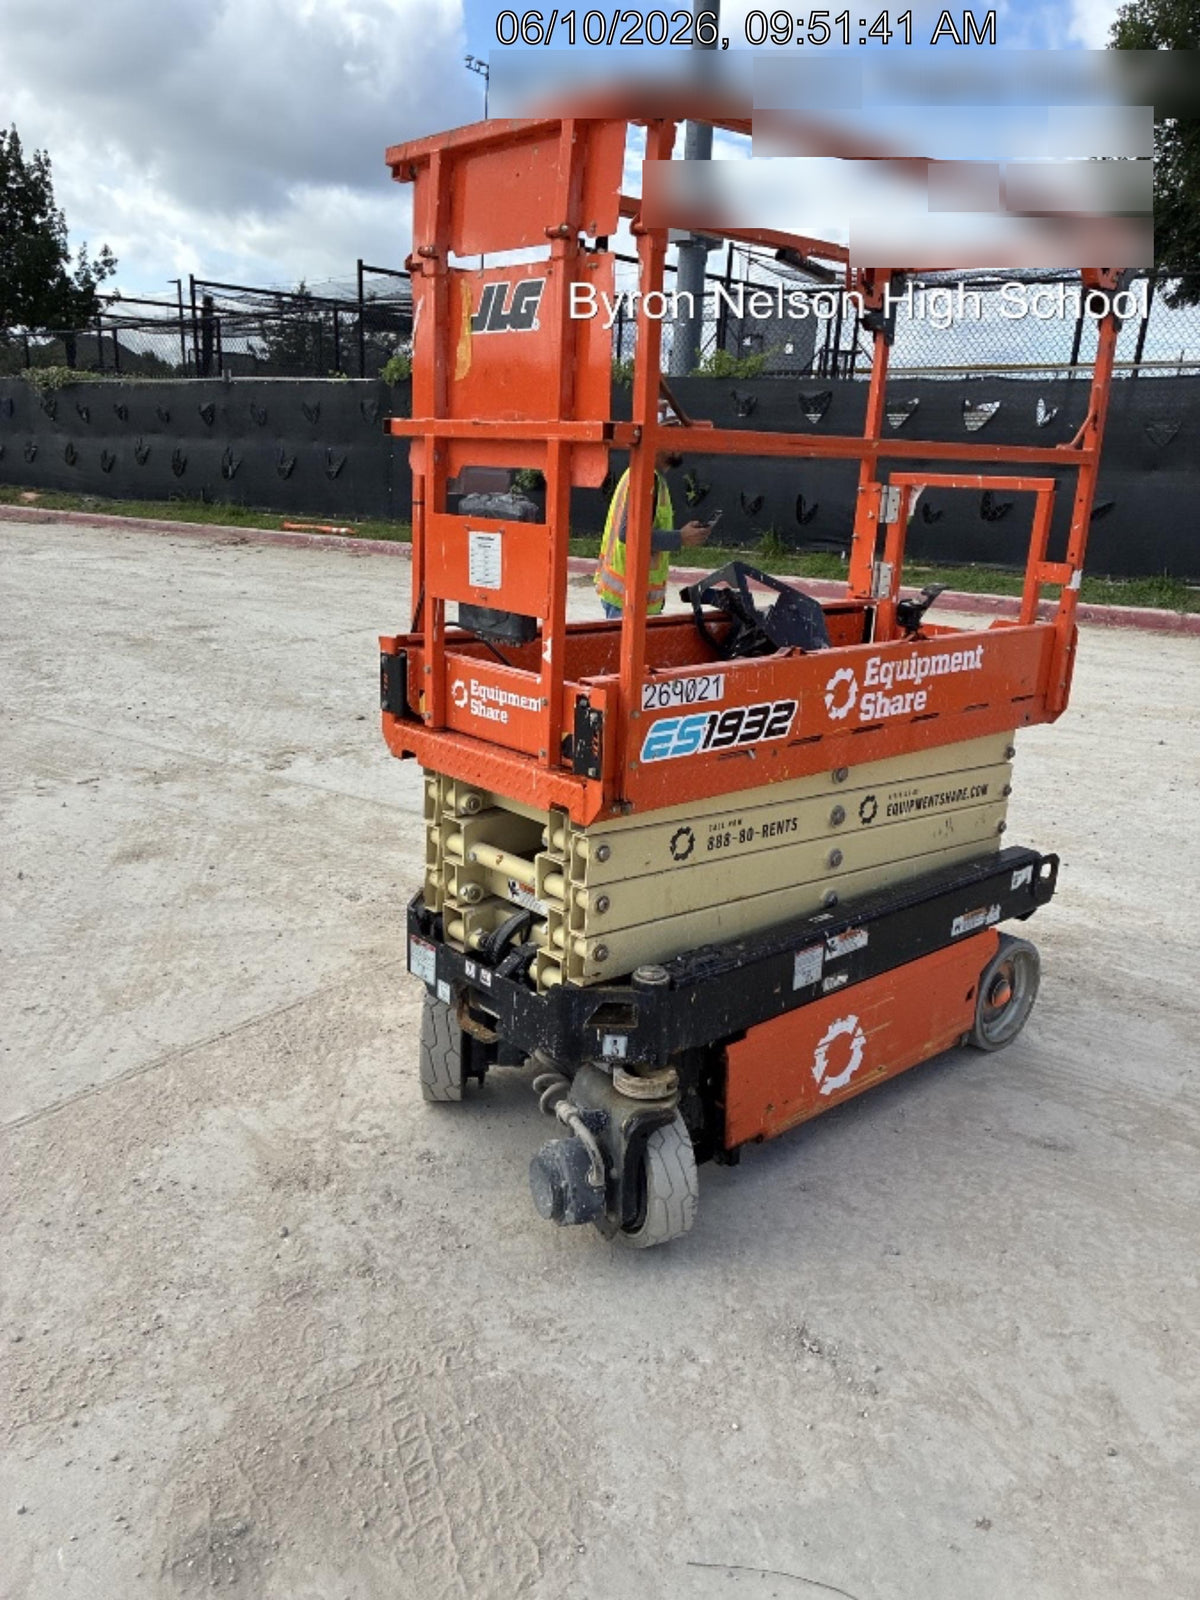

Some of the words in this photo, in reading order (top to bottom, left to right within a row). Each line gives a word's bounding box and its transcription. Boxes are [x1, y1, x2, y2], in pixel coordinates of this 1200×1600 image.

[470, 277, 546, 335] JLG
[863, 645, 984, 689] Equipment
[643, 675, 721, 710] 269021
[859, 690, 928, 721] Share
[470, 699, 508, 724] Share
[641, 700, 798, 763] ES1932
[707, 817, 798, 851] 888-80-RENTS
